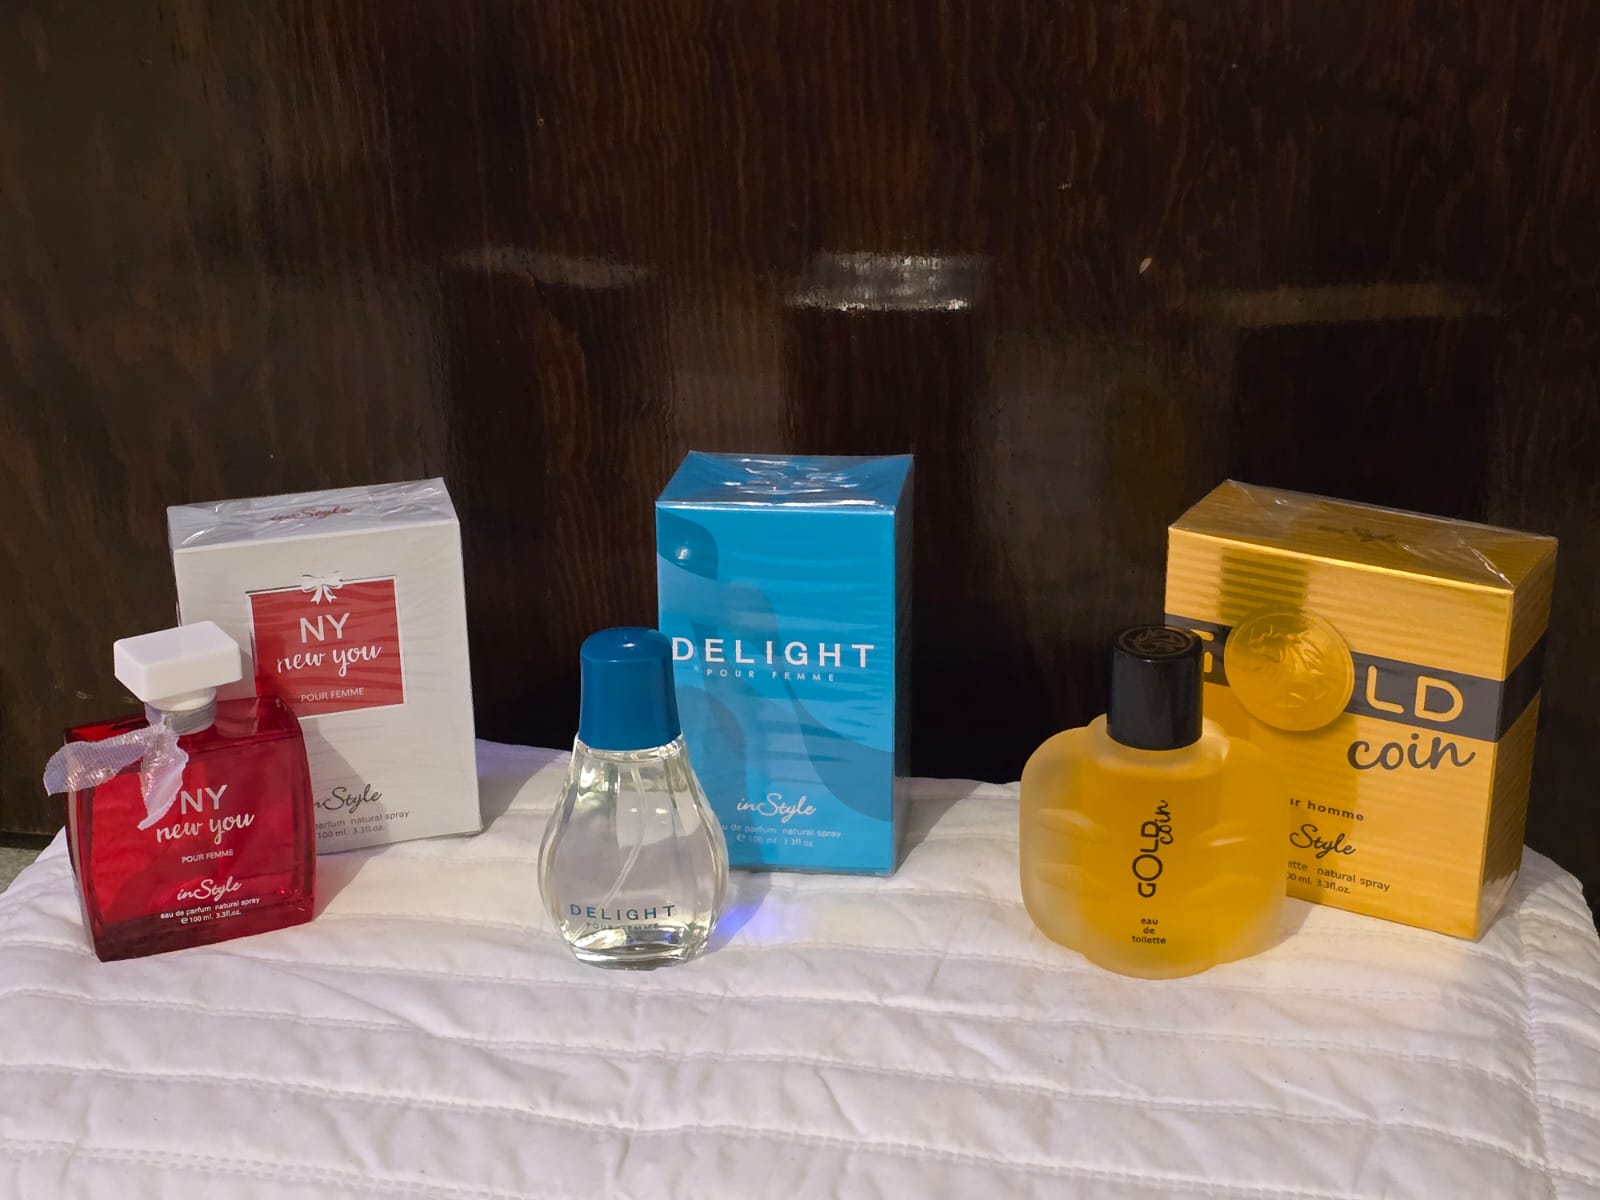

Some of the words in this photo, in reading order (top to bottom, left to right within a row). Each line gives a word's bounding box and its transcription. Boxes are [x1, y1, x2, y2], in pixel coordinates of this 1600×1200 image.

[299, 612, 350, 644] NY
[277, 652, 326, 673] new
[332, 645, 382, 677] you
[672, 637, 875, 668] DELIGHT
[706, 668, 755, 679] POUR
[772, 672, 834, 682] FEMME
[301, 692, 329, 703] POUR
[330, 687, 365, 699] FEMME
[1347, 733, 1476, 770] coin
[180, 784, 228, 815] NY
[314, 783, 383, 814] nStyle
[736, 792, 816, 823] inStyle
[1307, 800, 1364, 822] homme
[156, 822, 202, 843] new
[209, 813, 255, 845] you
[350, 813, 383, 825] natural
[385, 809, 410, 821] spray
[1155, 799, 1174, 845] coin
[317, 830, 333, 839] 100
[744, 824, 777, 834] parfum
[782, 827, 815, 837] natural
[817, 829, 841, 839] spray
[1289, 823, 1356, 859] Style
[181, 853, 204, 864] POUR
[206, 848, 234, 860] FEMME
[1132, 821, 1163, 898] GOLD
[177, 876, 242, 902] inStyle
[1317, 866, 1356, 882] natural
[1359, 876, 1391, 893] spray
[160, 910, 174, 919] eau
[175, 909, 185, 917] de
[185, 905, 212, 917] parfum
[214, 901, 239, 911] natural
[241, 897, 260, 907] spray
[570, 903, 675, 921] DELIGHT
[1140, 917, 1158, 925] eau
[1131, 935, 1166, 944] toilette
[1142, 926, 1155, 934] de
